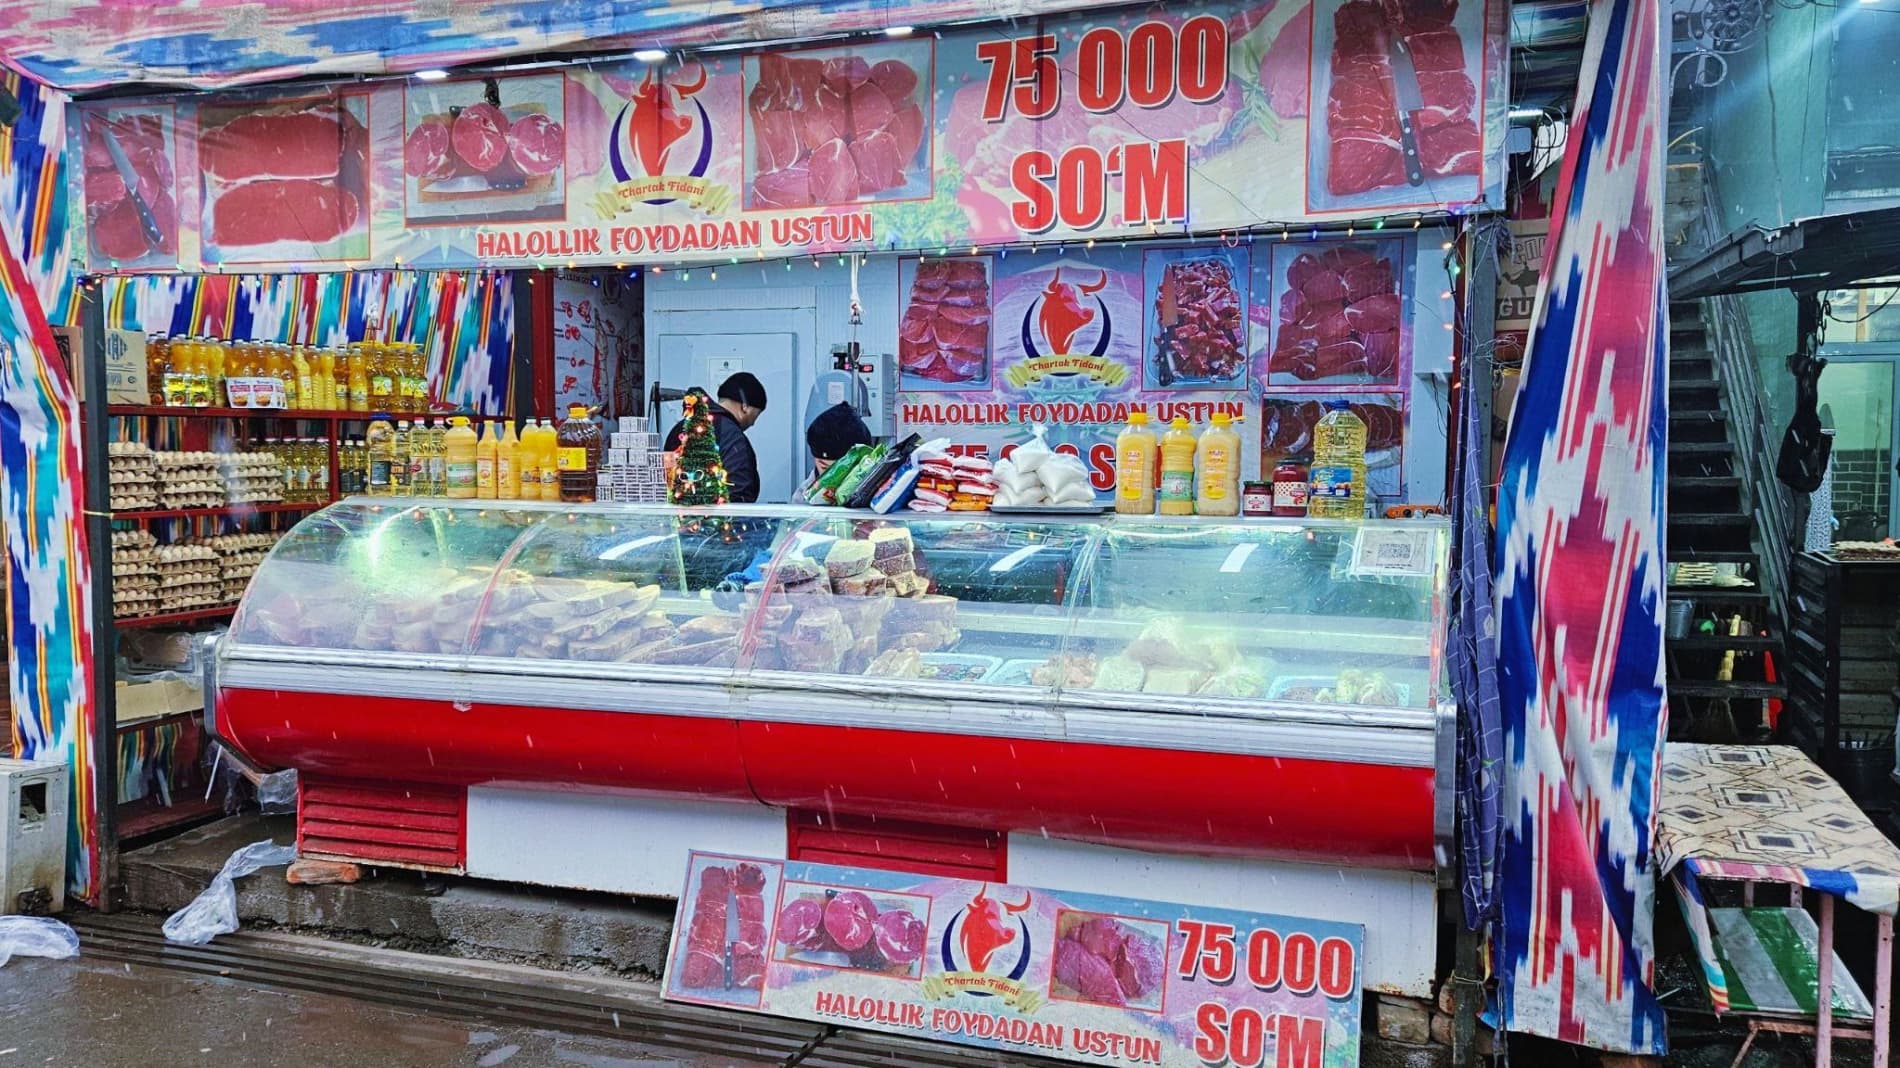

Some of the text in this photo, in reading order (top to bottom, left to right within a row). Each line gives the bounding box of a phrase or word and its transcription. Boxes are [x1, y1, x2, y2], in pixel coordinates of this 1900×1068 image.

[977, 15, 1228, 122] 75 000
[618, 180, 704, 198] Chartak Fidani
[1011, 138, 1188, 233] SO‘M
[477, 213, 874, 257] HALOLLIK FOYDADAN USTUN
[1028, 358, 1104, 371] Chartak Fidani
[903, 401, 1244, 424] HALOLLIK FOYDADAN USTUN
[1177, 920, 1356, 1003] 75 000
[944, 976, 1020, 996] Chartak Fidani
[815, 990, 1162, 1064] HALOLLIK FOYDADAN USTUN
